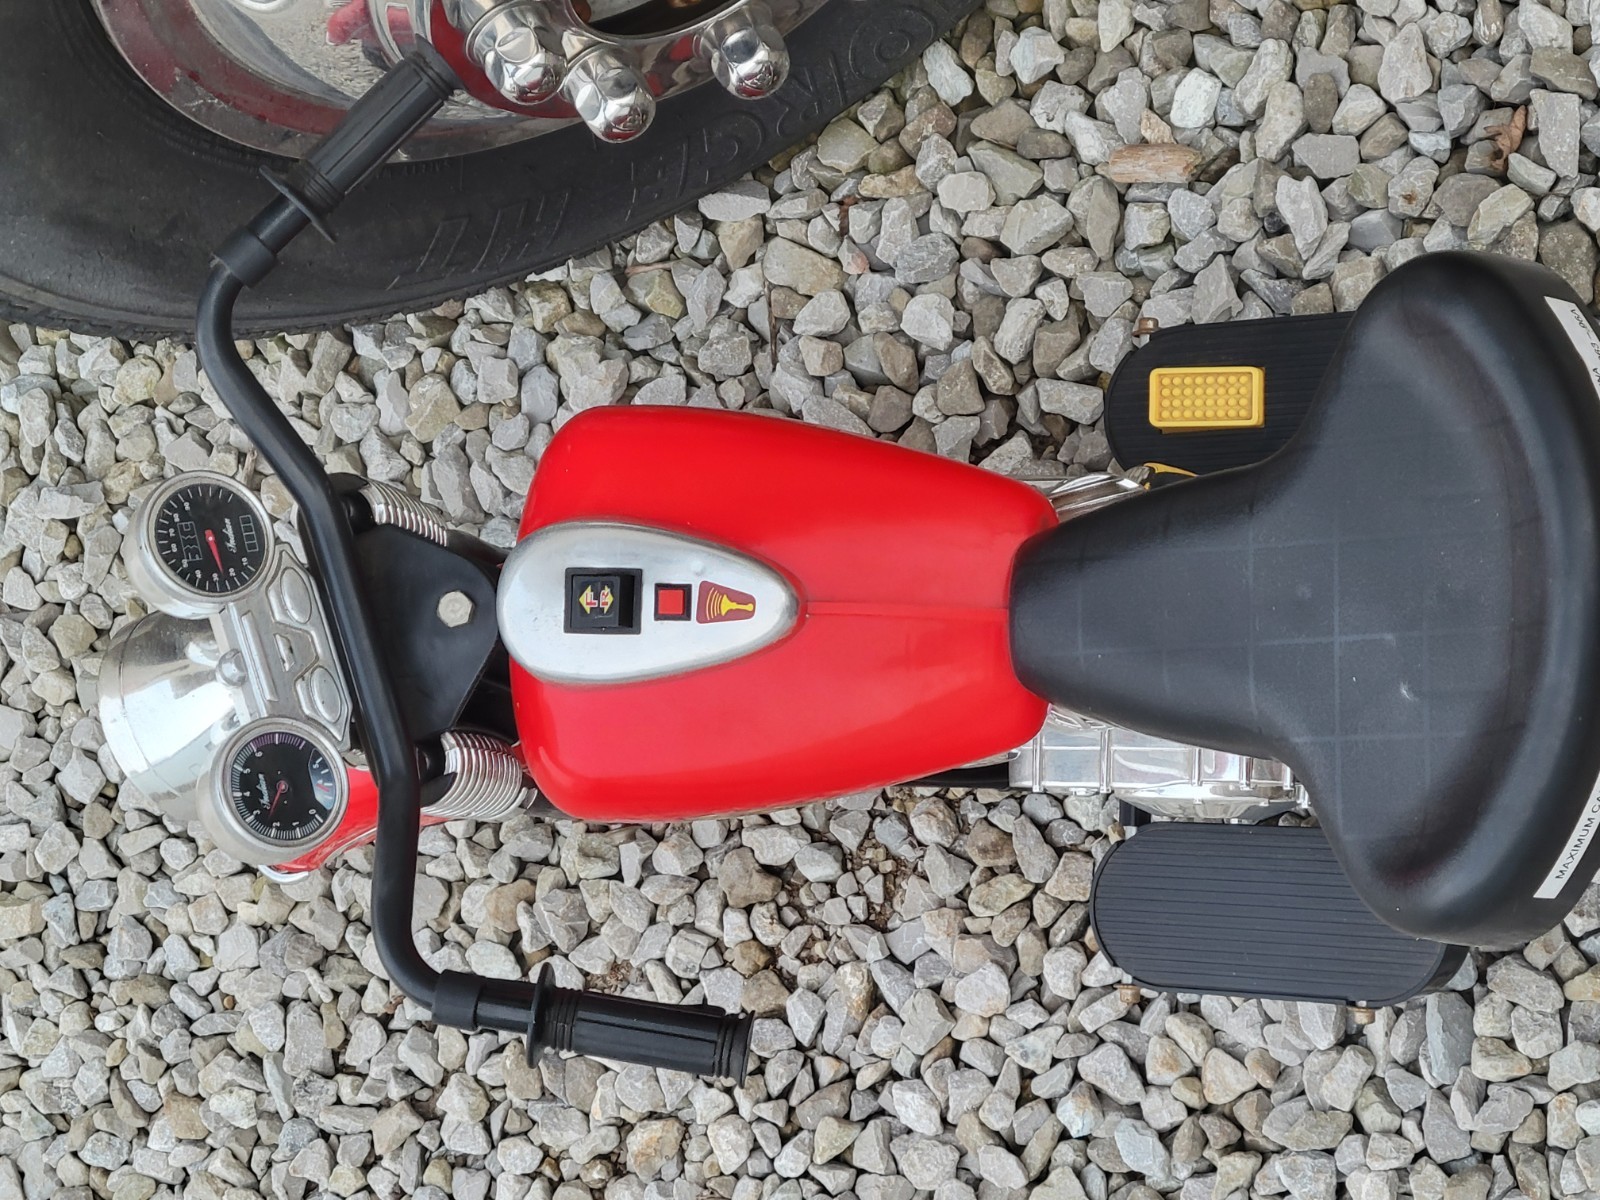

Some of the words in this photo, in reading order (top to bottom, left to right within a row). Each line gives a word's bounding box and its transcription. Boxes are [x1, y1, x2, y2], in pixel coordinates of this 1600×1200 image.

[184, 502, 190, 511] 90
[173, 513, 180, 522] 80
[169, 528, 175, 537] 70
[222, 517, 237, 553] Indian
[171, 543, 178, 552] 60
[241, 557, 248, 566] 10
[195, 570, 202, 579] 40
[229, 568, 236, 577] 20
[212, 573, 219, 582] 30
[585, 591, 598, 608] F
[599, 588, 611, 608] R
[256, 773, 271, 810] Indian
[1555, 817, 1596, 879] MAXIMUM
